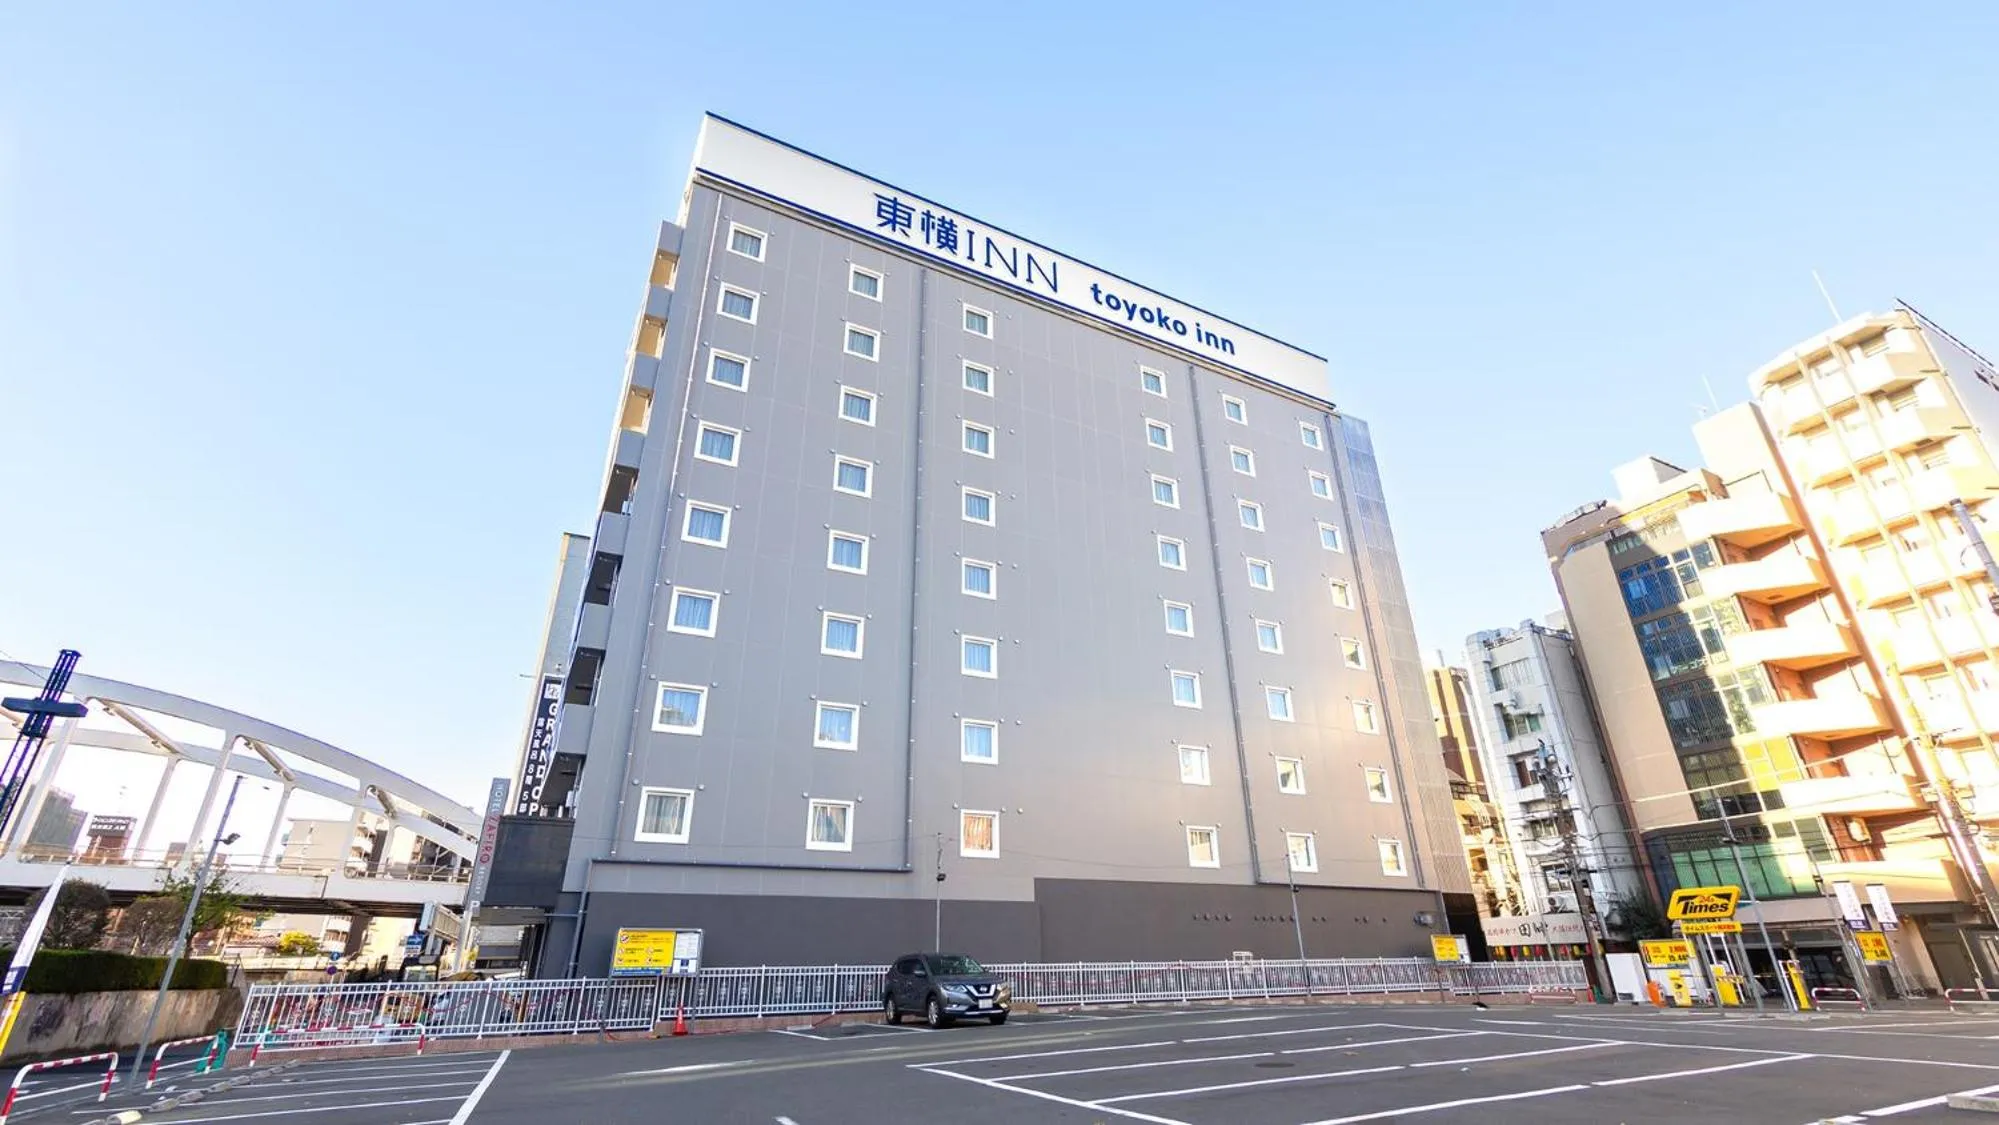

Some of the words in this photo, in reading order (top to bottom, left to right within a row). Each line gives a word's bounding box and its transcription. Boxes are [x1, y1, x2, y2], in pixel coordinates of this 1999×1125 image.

[873, 192, 1058, 294] 東横INN
[1090, 283, 1187, 336] toyoko
[1195, 323, 1235, 356] inn
[491, 783, 504, 812] HOTEL
[479, 815, 501, 864] ZAFIRO
[1681, 901, 1729, 915] Times
